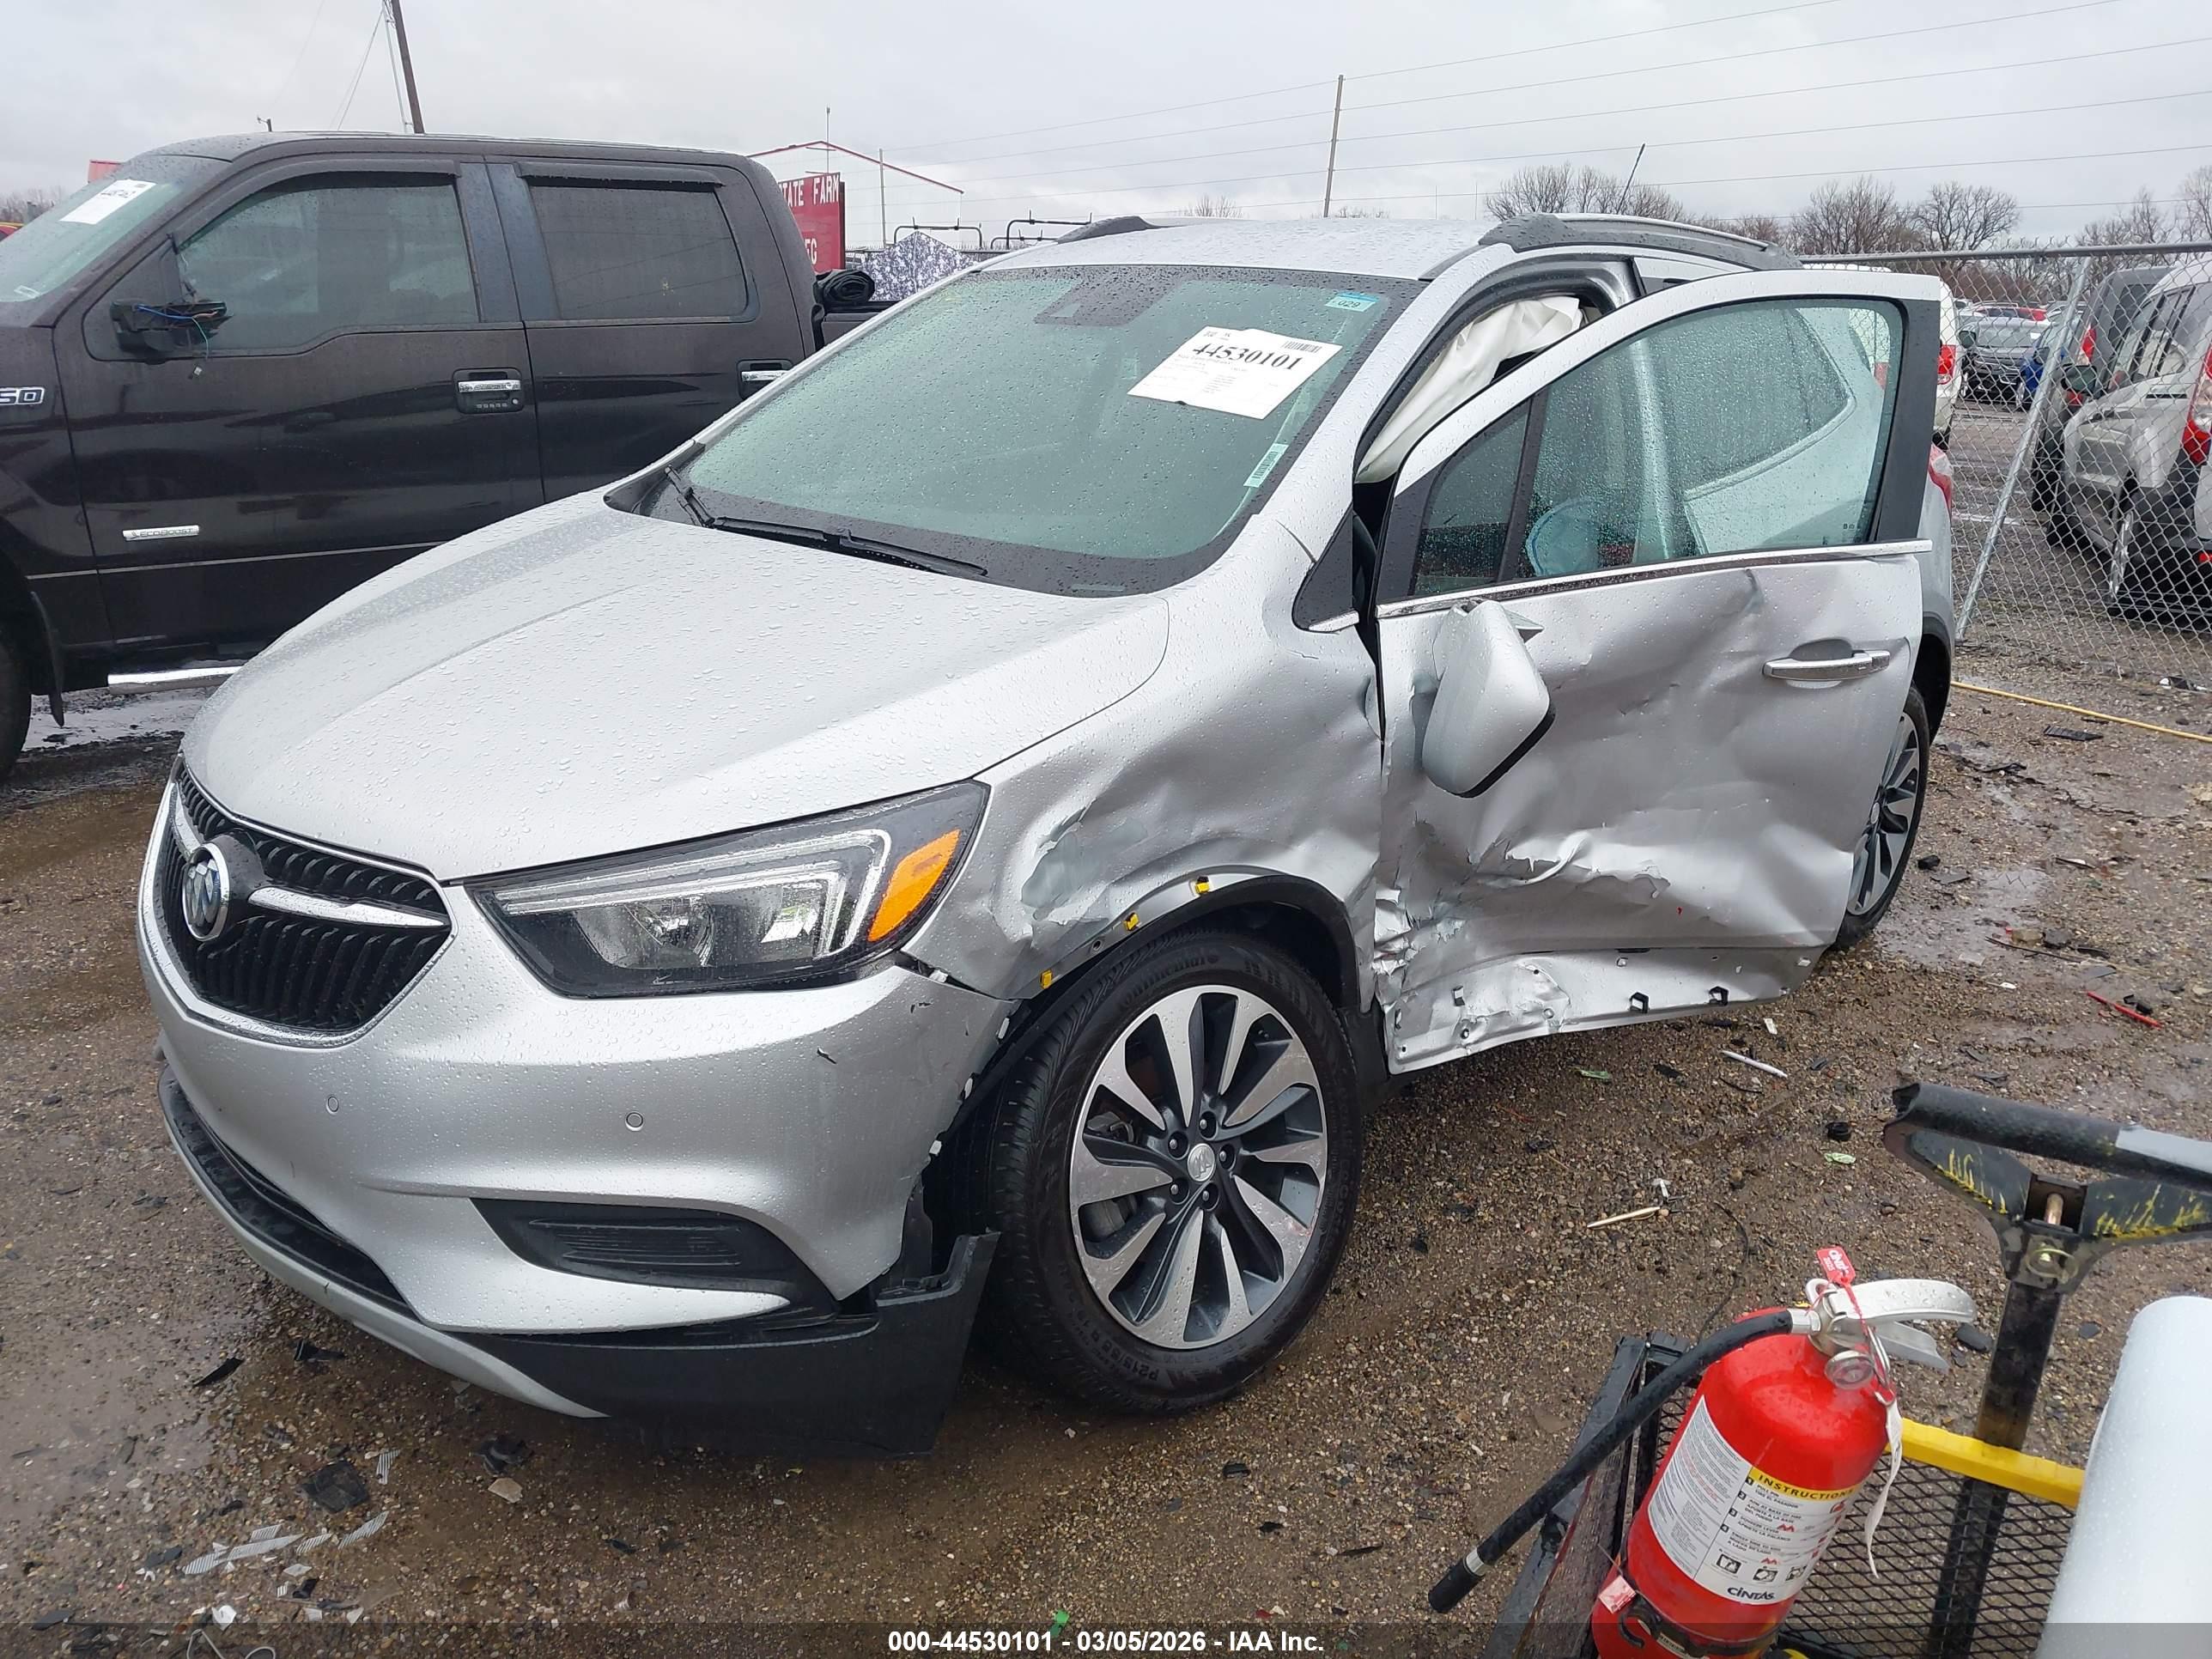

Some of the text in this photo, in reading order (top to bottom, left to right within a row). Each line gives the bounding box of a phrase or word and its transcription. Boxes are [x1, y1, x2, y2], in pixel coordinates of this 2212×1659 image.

[779, 174, 839, 207] TATE FARM
[1192, 343, 1304, 370] 44530101
[1758, 1474, 1853, 1500] INSTRUCTIONS
